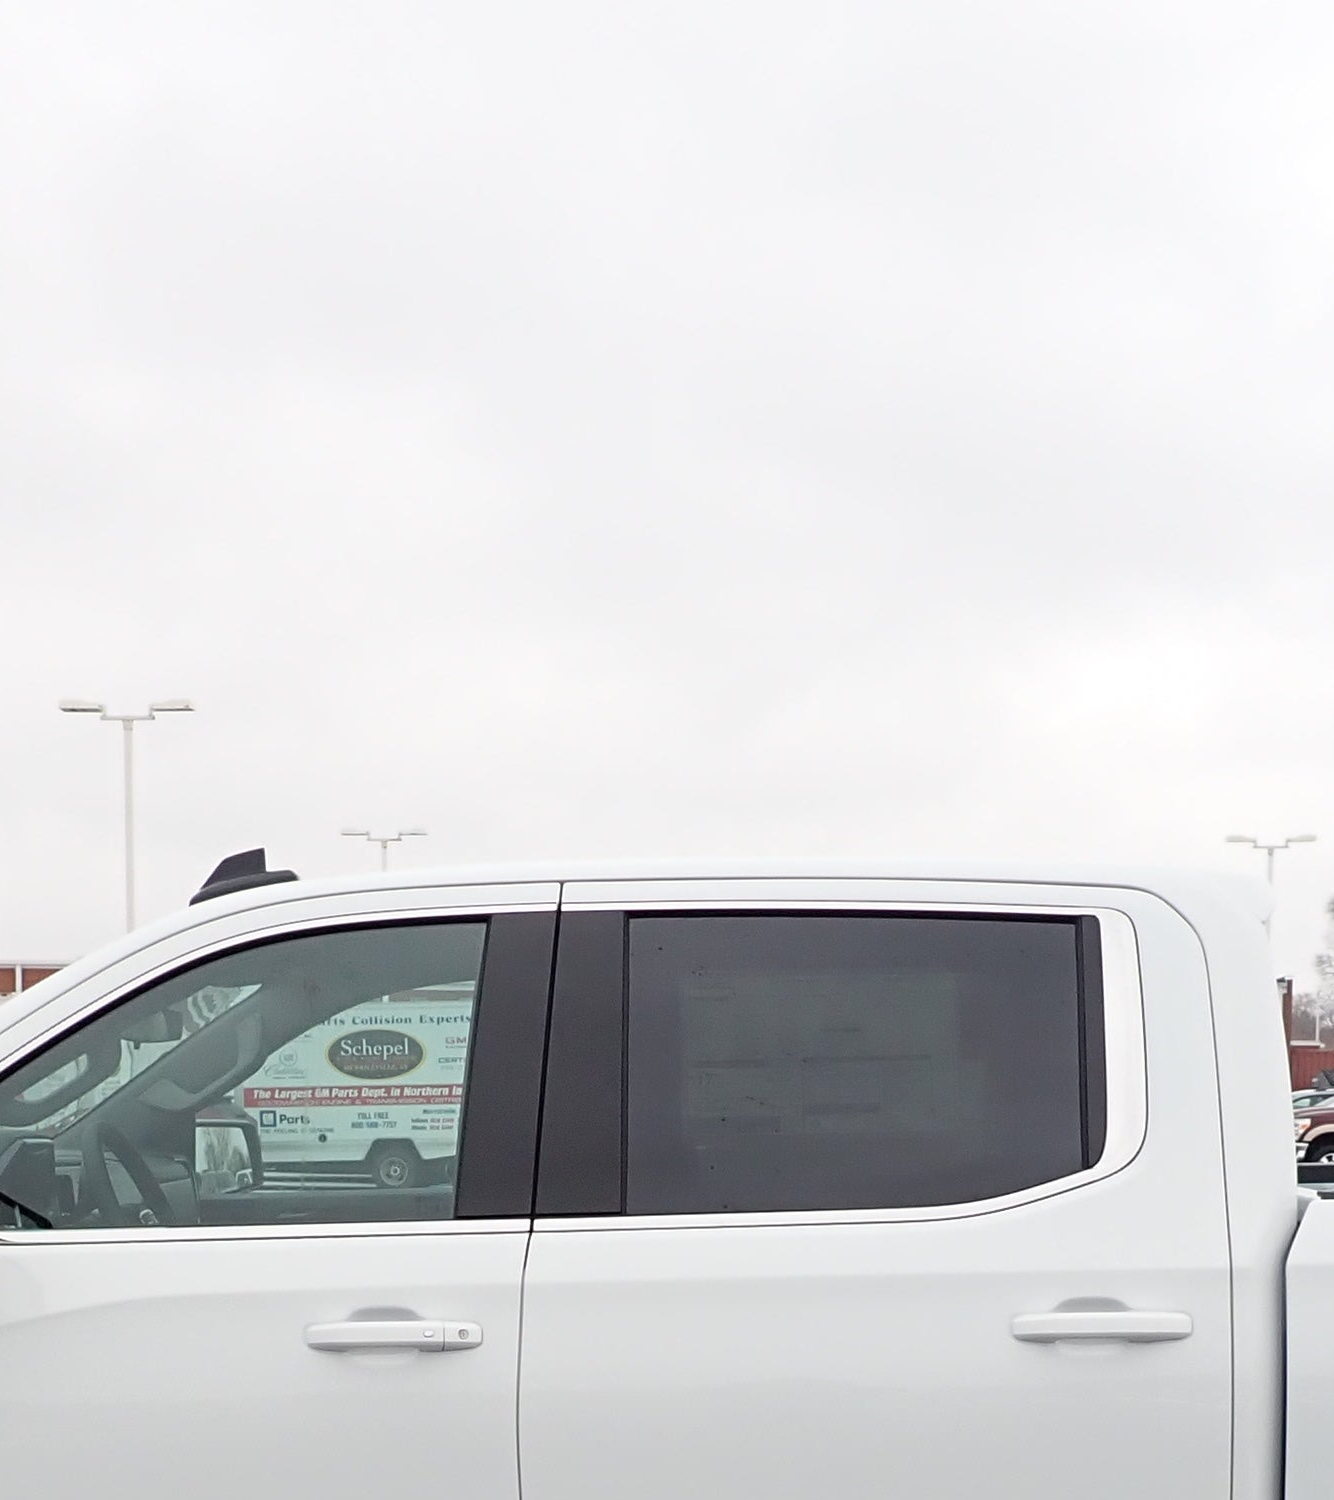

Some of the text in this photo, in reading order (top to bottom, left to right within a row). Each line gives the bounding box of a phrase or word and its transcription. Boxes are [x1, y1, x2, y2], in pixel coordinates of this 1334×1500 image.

[352, 1015, 412, 1025] Collision
[419, 1014, 471, 1025] Experts
[341, 1038, 408, 1060] Schepel
[253, 1089, 271, 1099] The
[275, 1089, 313, 1100] Largest
[315, 1088, 330, 1098] GM
[331, 1088, 358, 1098] Parts
[361, 1087, 388, 1098] Dept.
[403, 1086, 449, 1096] Northern
[279, 1113, 311, 1124] Parts
